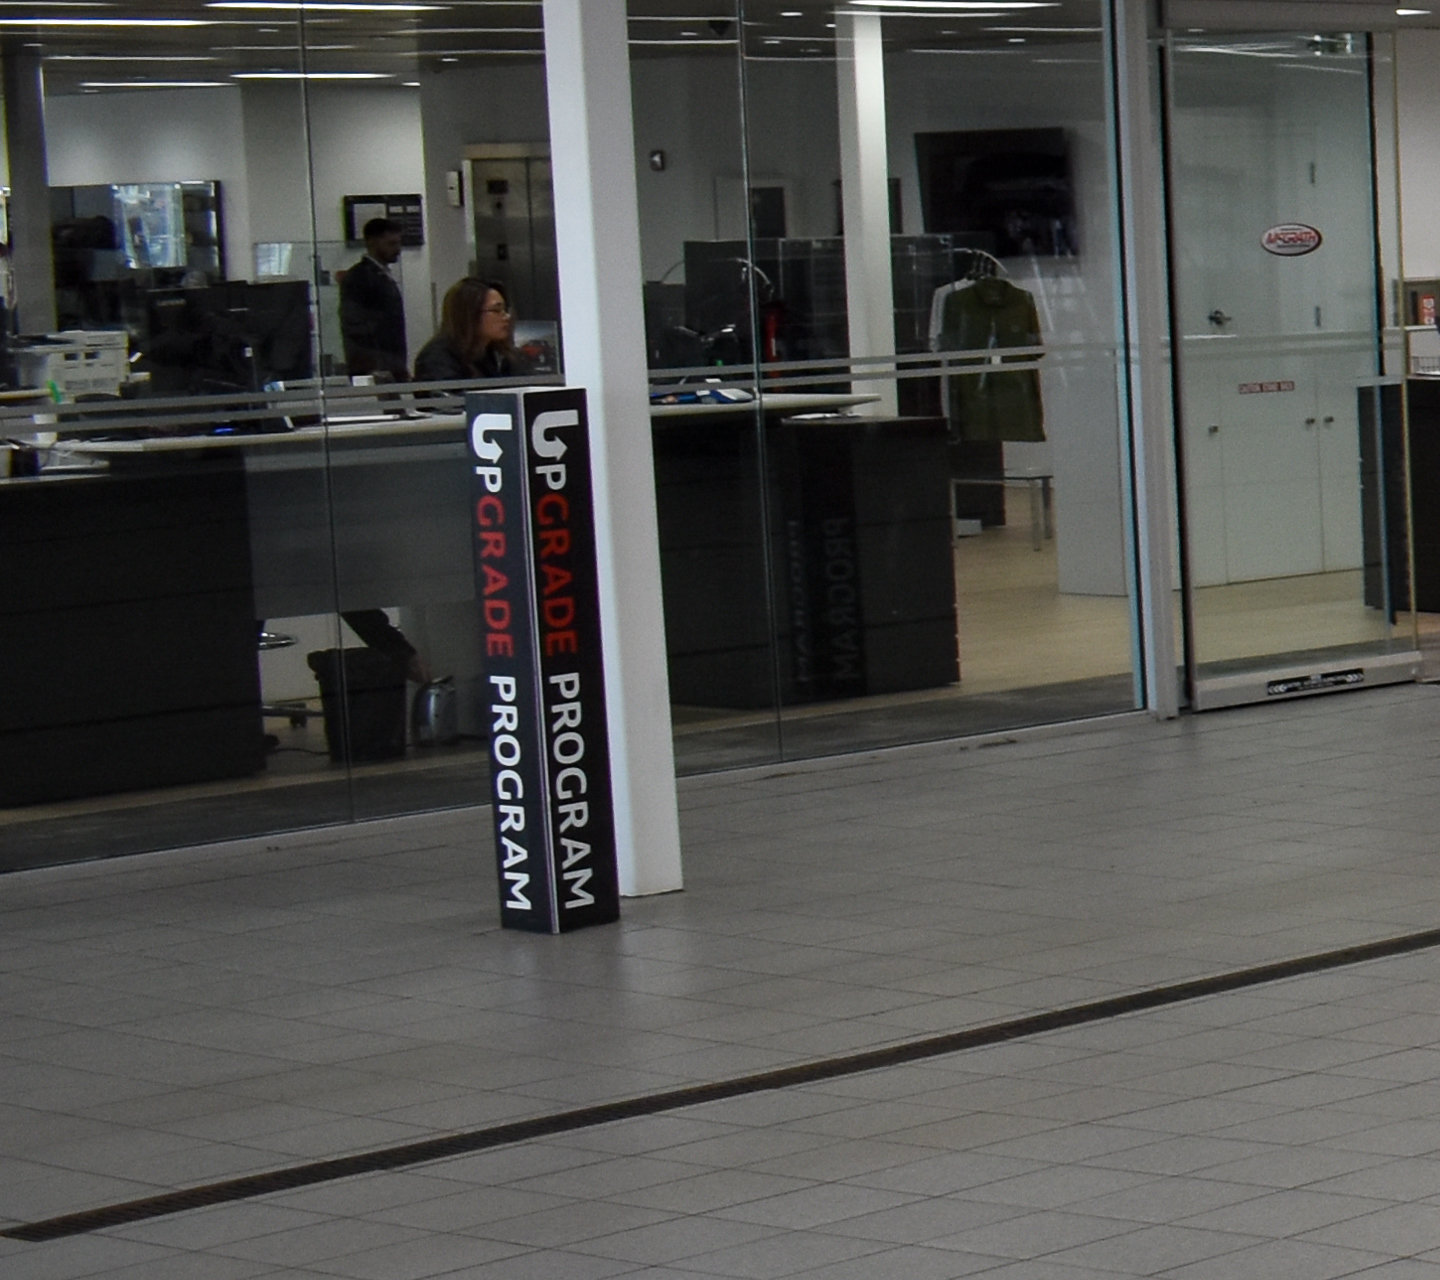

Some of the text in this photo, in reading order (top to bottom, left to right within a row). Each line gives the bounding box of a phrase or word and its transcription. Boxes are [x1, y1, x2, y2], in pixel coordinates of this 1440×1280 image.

[472, 413, 532, 910] UPGRADE PROGRAM
[531, 409, 595, 909] UPGRADE PROGRAM
